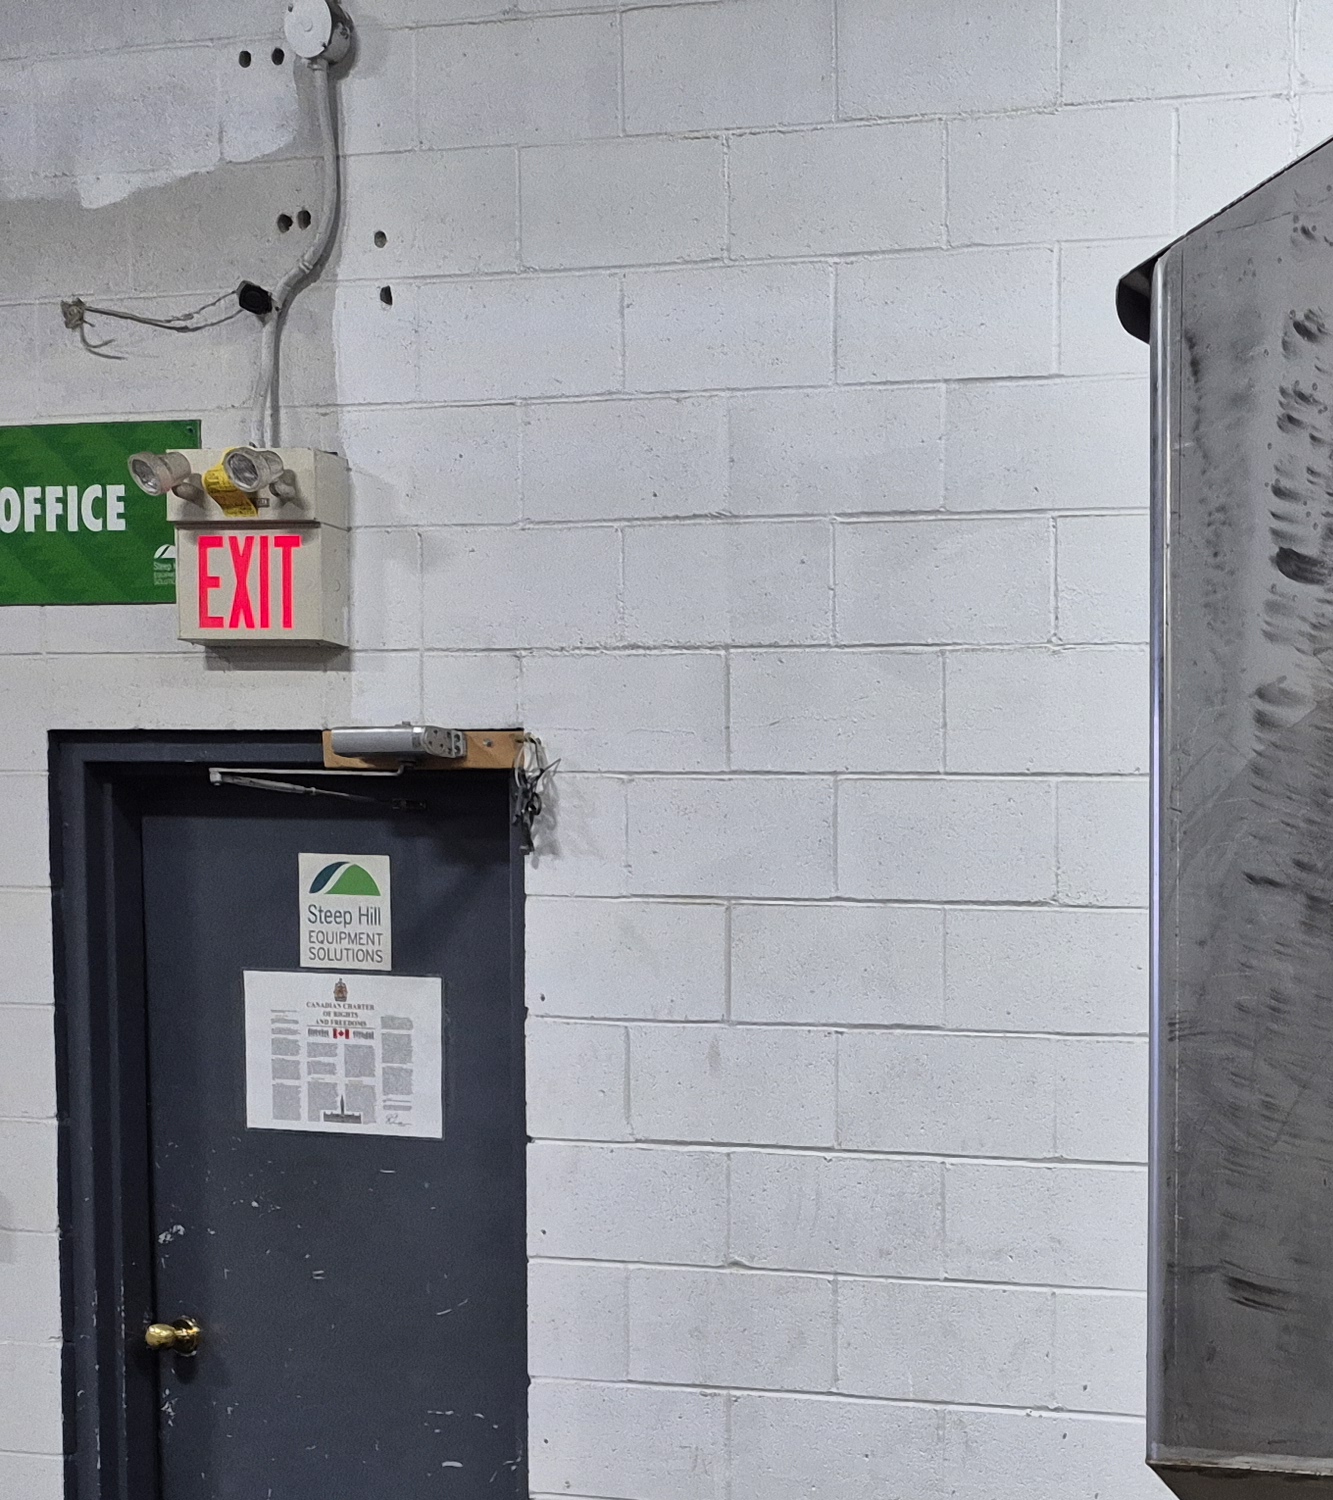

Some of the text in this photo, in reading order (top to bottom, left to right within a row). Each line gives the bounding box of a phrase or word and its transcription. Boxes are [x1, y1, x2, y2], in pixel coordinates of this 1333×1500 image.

[0, 484, 126, 534] OFFICE
[198, 535, 302, 629] EXIT
[308, 904, 381, 928] Steep Hill
[308, 930, 383, 946] EQUIPMENT
[308, 946, 383, 963] SOLUTIONS
